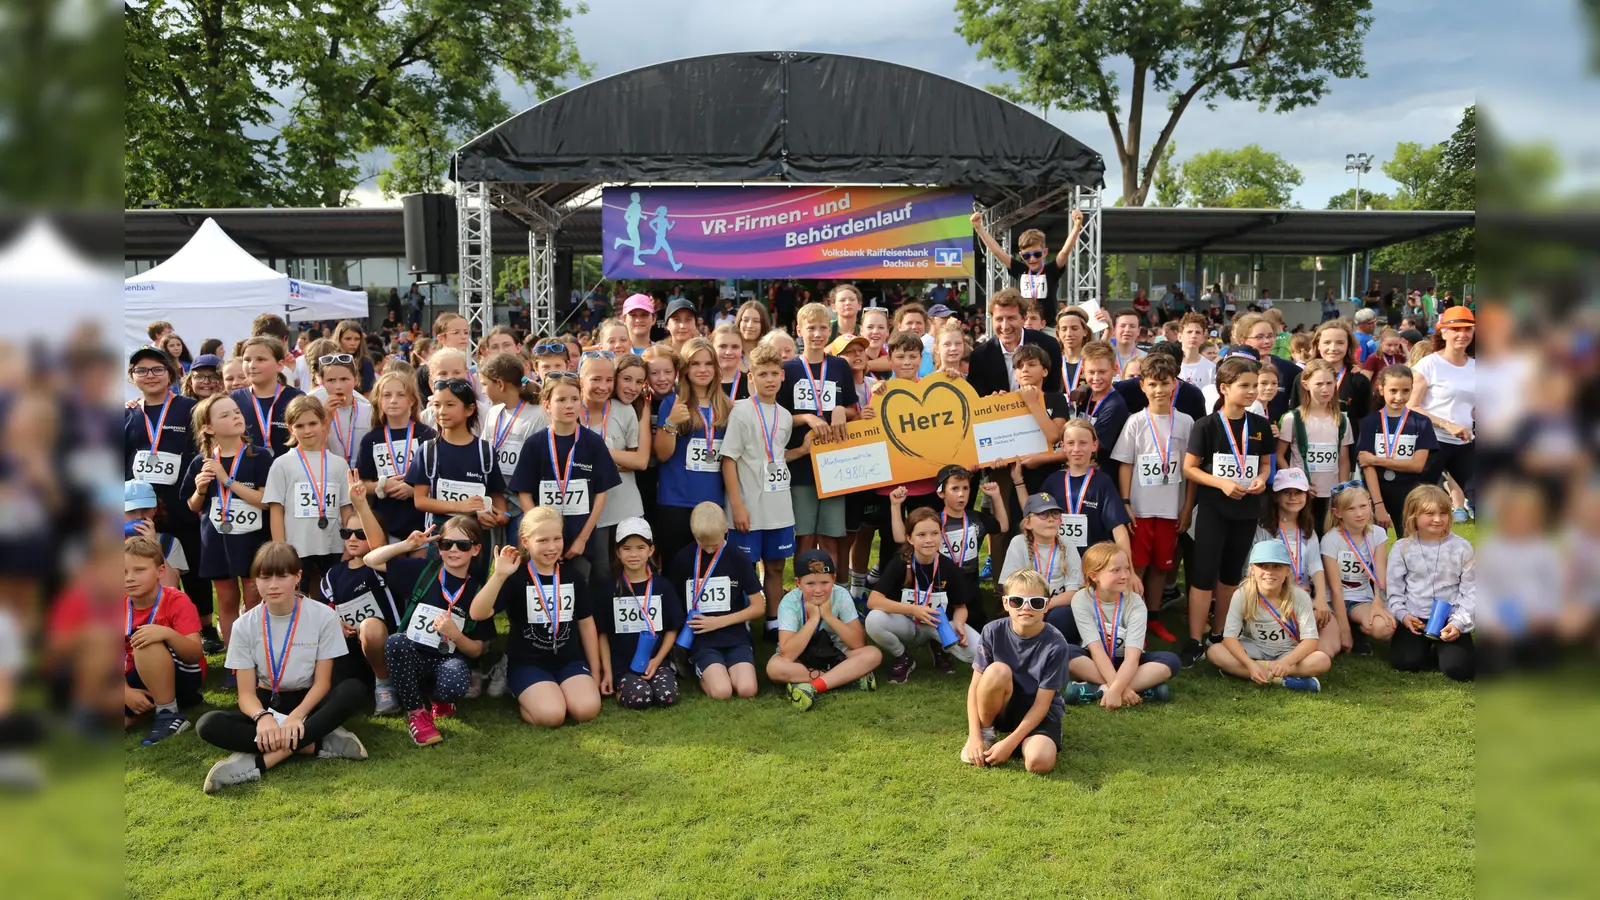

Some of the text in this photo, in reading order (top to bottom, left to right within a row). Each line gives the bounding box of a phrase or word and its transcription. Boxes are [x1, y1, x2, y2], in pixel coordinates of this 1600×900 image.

[701, 192, 851, 236] VR-Firmen- und
[785, 202, 913, 248] Behördenlauf
[822, 248, 928, 257] Volksbank Raiffeisenbank
[883, 260, 928, 268] Dachau eG
[974, 400, 1029, 416] und Versta
[899, 410, 955, 433] Herz
[864, 426, 880, 437] mit
[1378, 442, 1414, 456] 383
[1307, 451, 1337, 463] 3599
[136, 461, 174, 475] 3558
[1142, 461, 1177, 476] 3607
[1217, 464, 1254, 478] 3598
[544, 490, 584, 505] 3577
[214, 508, 257, 525] 3569
[942, 537, 975, 554] 366
[691, 587, 726, 602] 613
[340, 604, 375, 626] 565
[1258, 629, 1292, 641] 361
